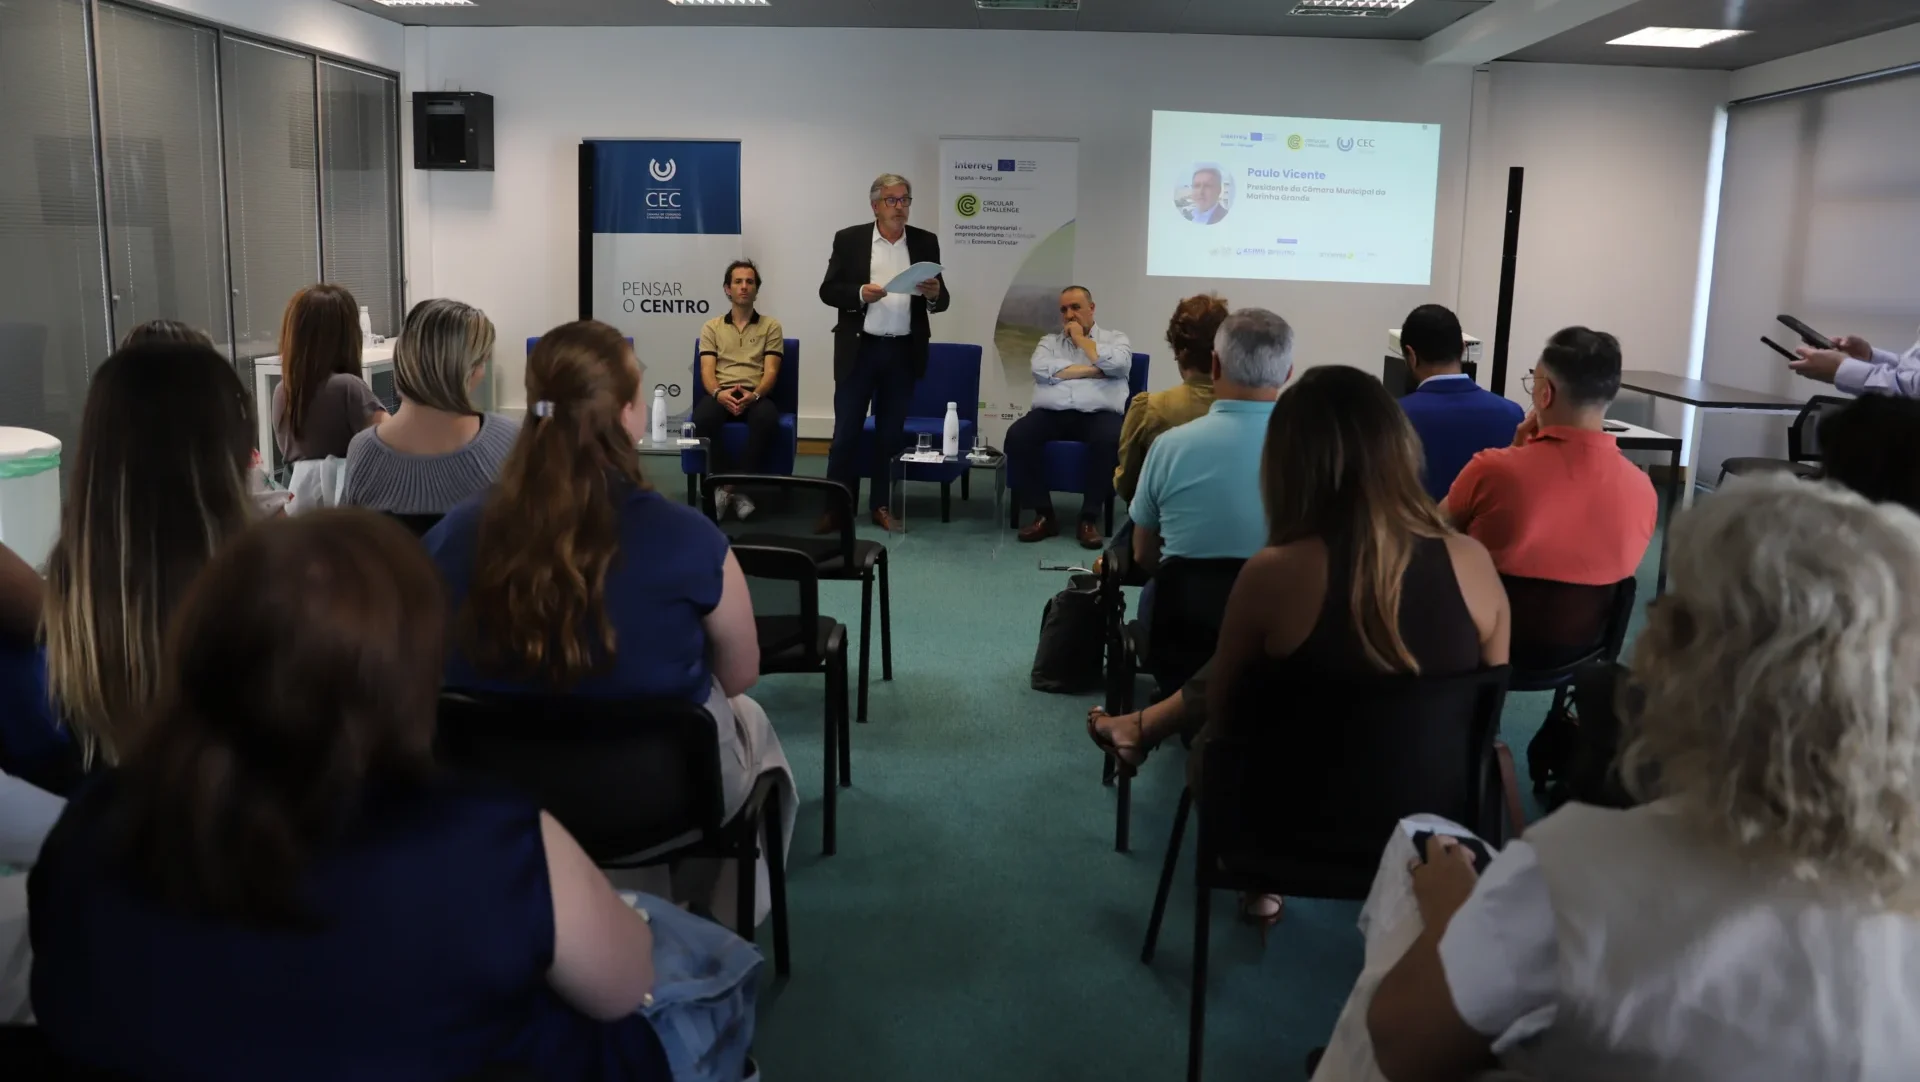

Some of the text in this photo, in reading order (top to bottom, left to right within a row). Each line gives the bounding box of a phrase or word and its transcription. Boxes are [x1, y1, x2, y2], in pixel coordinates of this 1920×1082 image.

[1356, 138, 1376, 148] CEC
[1247, 167, 1327, 180] Paulo Vicente
[1246, 183, 1289, 192] Presidente
[1290, 184, 1301, 192] da
[1336, 187, 1375, 196] Municipal
[645, 192, 682, 208] CEC
[1246, 192, 1311, 202] Marinha Grande
[622, 281, 683, 297] PENSAR
[623, 298, 710, 314] O CENTRO
